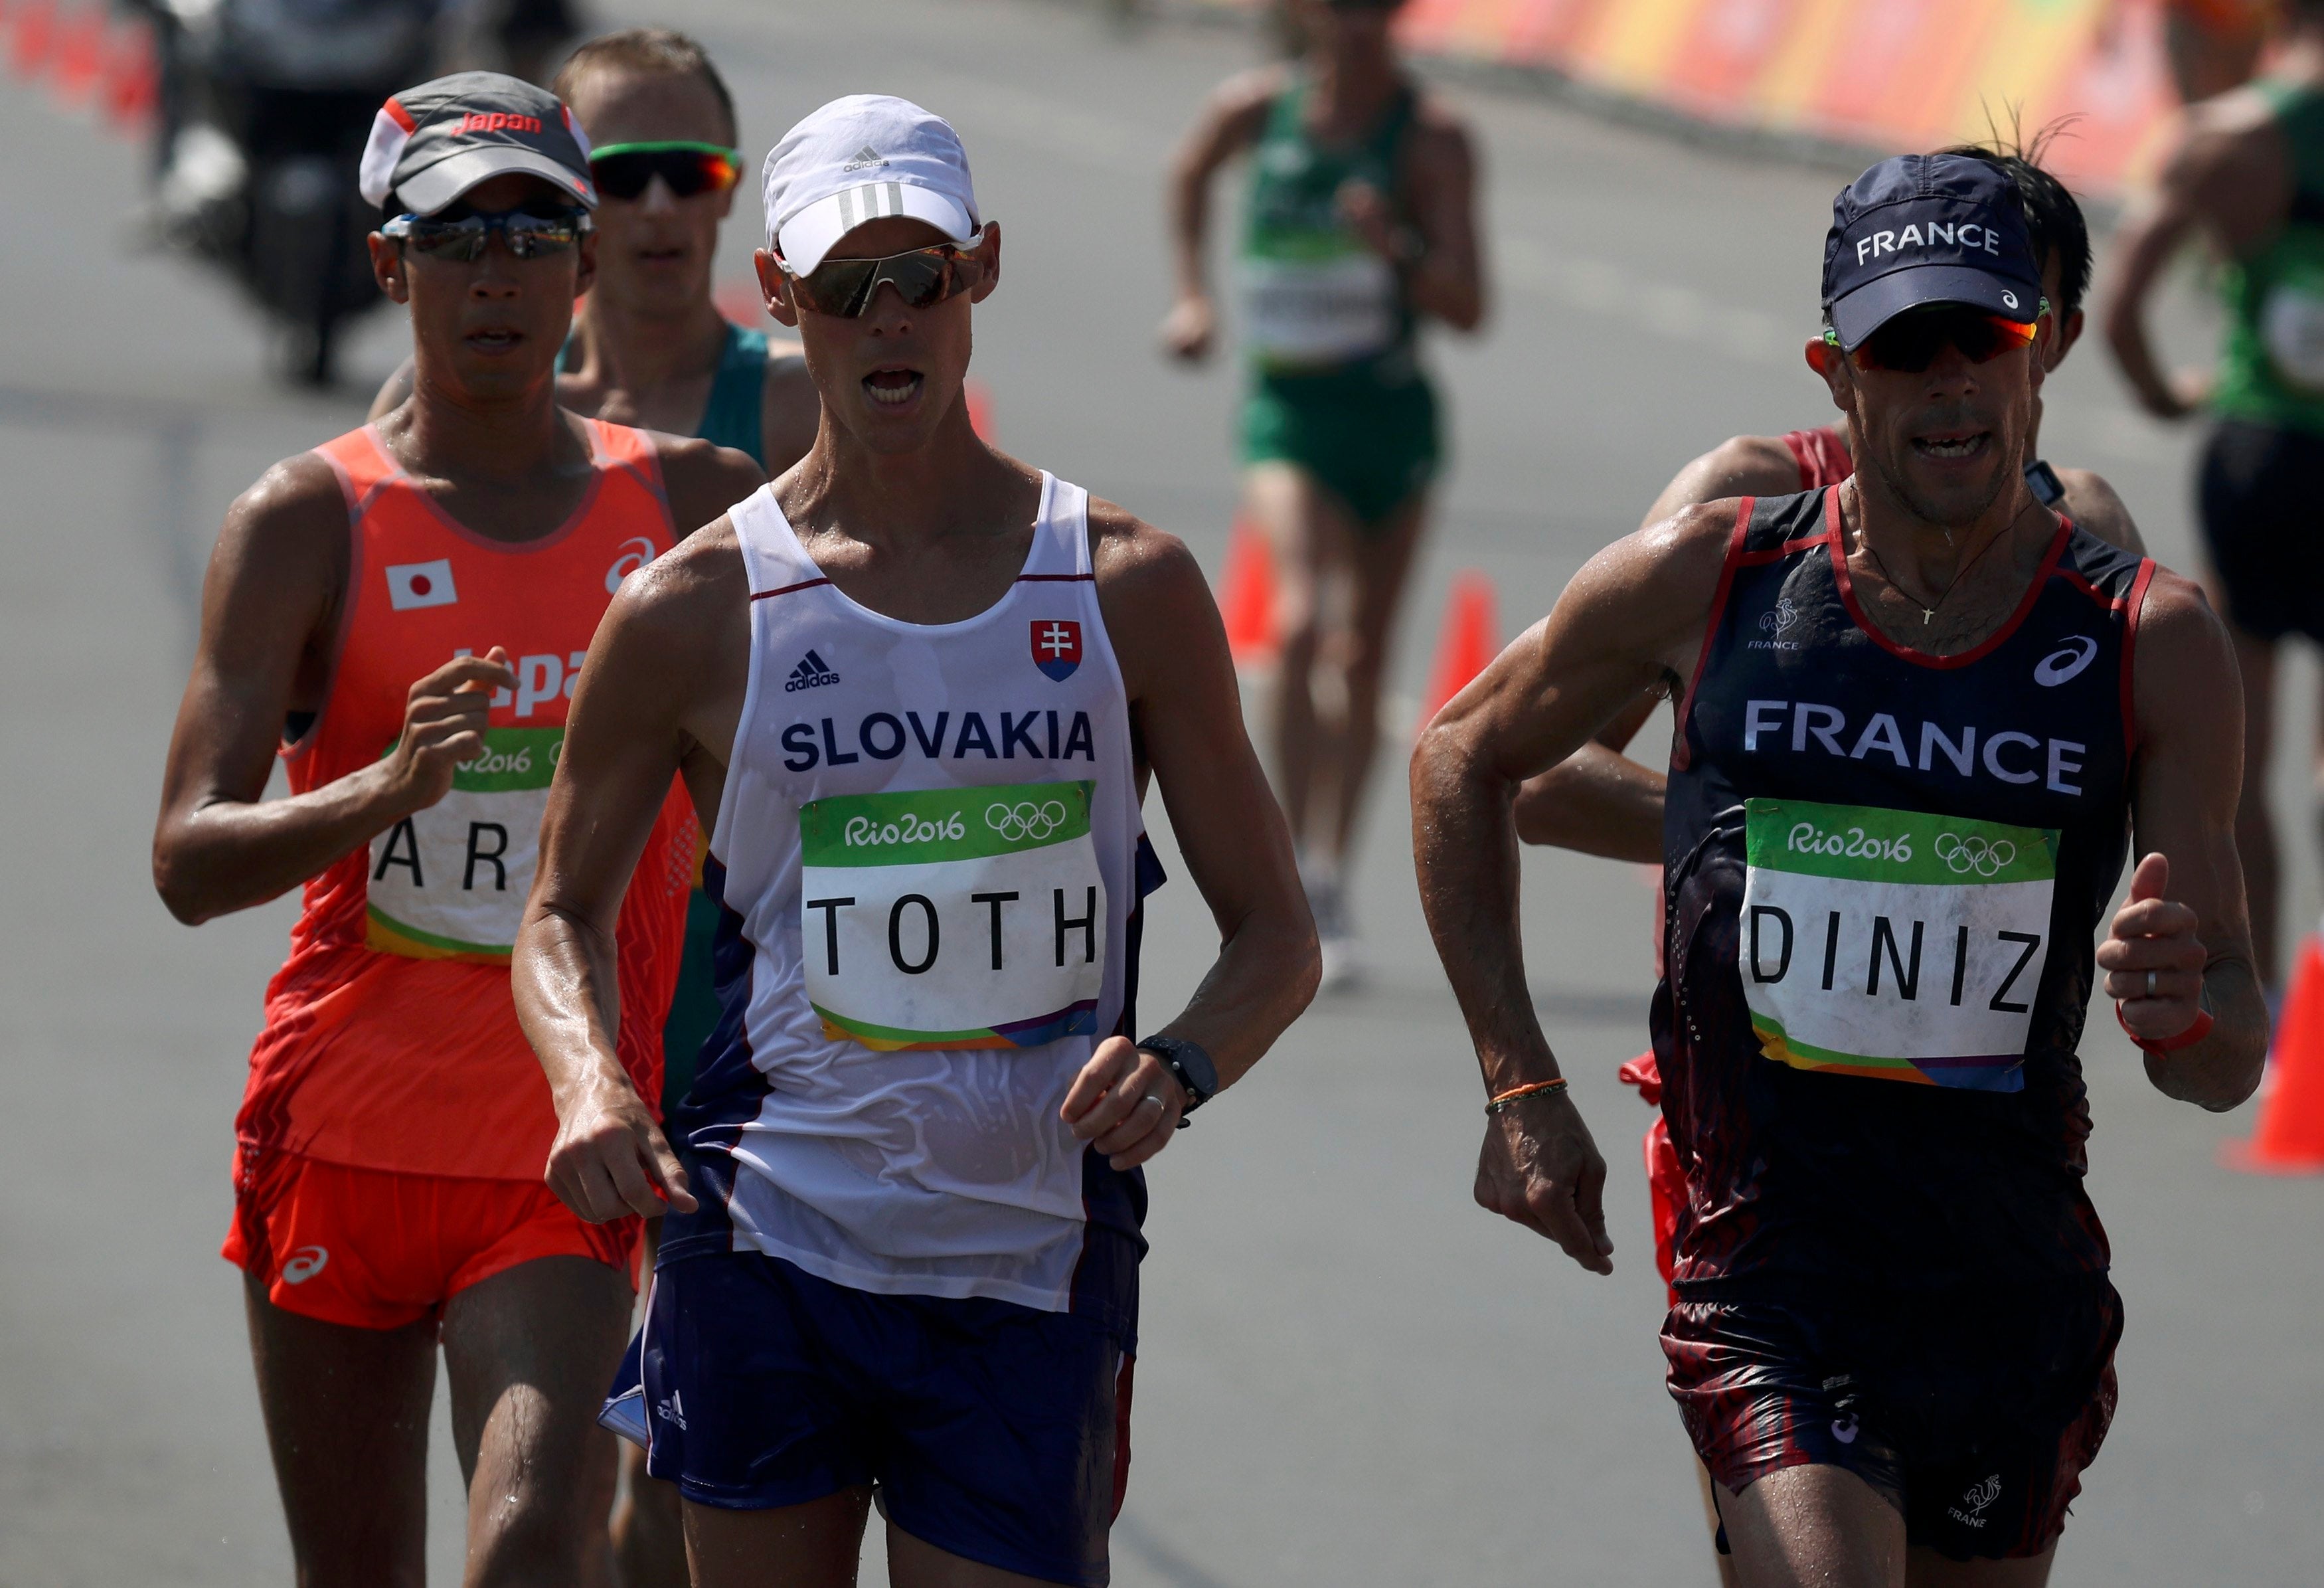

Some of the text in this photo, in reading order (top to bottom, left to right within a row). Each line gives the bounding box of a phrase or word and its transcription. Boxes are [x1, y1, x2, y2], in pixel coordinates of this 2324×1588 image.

[451, 112, 542, 136] Japan
[843, 160, 890, 172] adidas
[1857, 222, 2000, 266] FRANCE
[1747, 641, 1799, 650] FRANCE
[785, 671, 840, 693] adidas
[781, 711, 1096, 772] SLOVAKIA
[1744, 700, 2086, 796] FRANCE
[807, 885, 1096, 976] TOTH
[1750, 905, 2040, 1014] DINIZ
